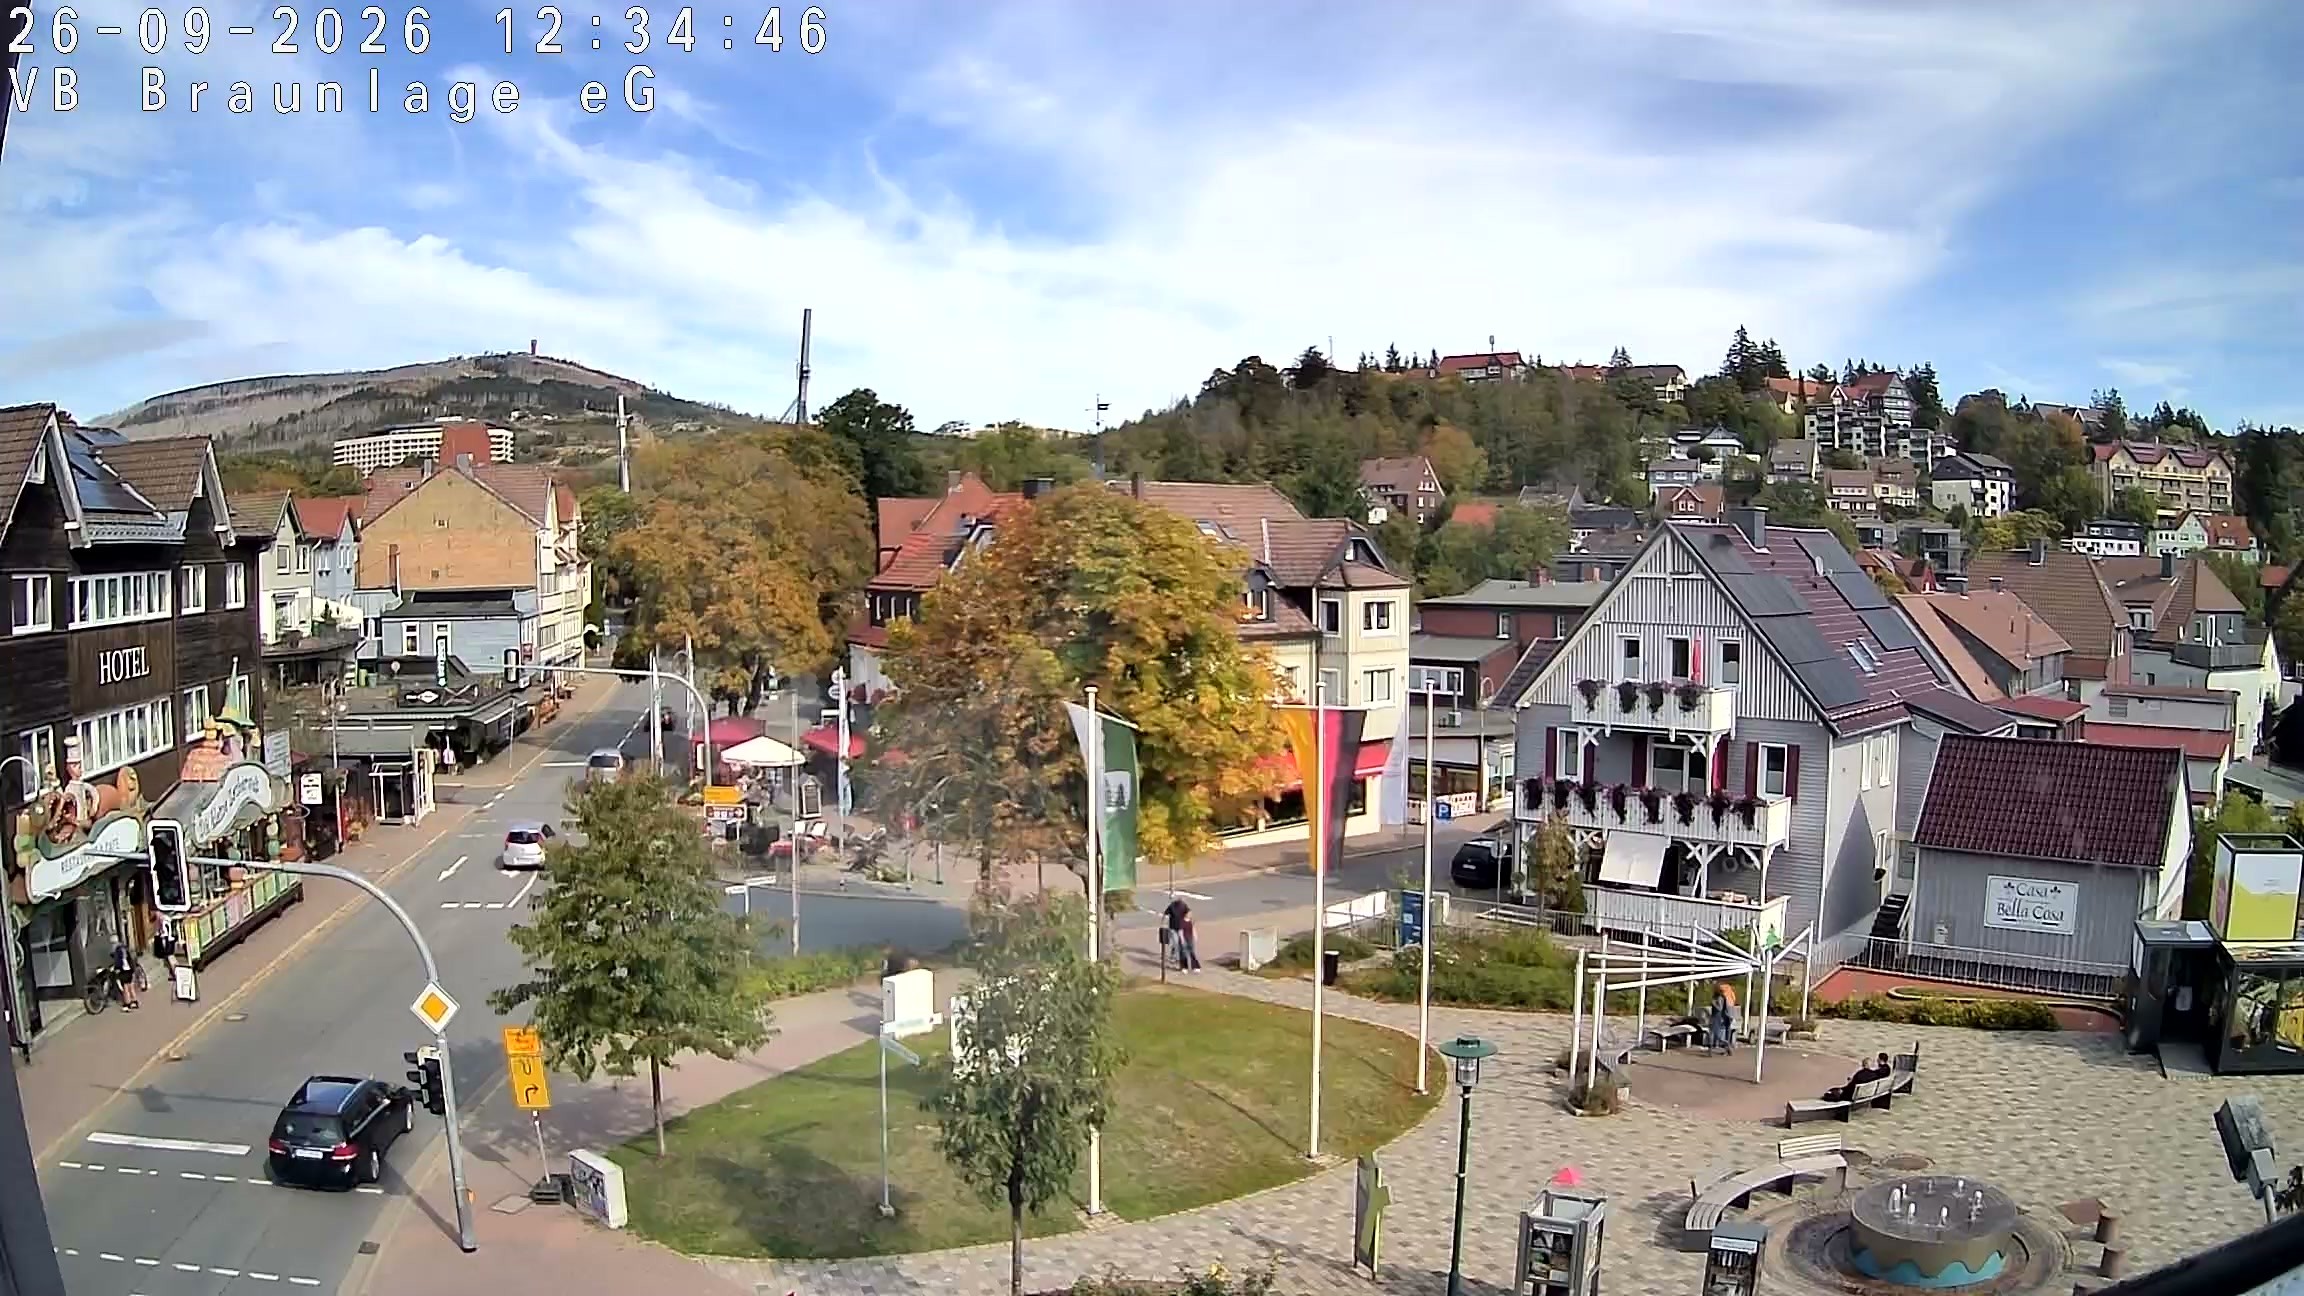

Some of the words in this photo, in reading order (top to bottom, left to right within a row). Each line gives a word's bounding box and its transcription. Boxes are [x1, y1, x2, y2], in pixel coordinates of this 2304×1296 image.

[99, 646, 150, 685] HOTEL
[2016, 883, 2048, 897] Casa
[1997, 898, 2029, 918] Bella
[2032, 906, 2064, 921] Casa
